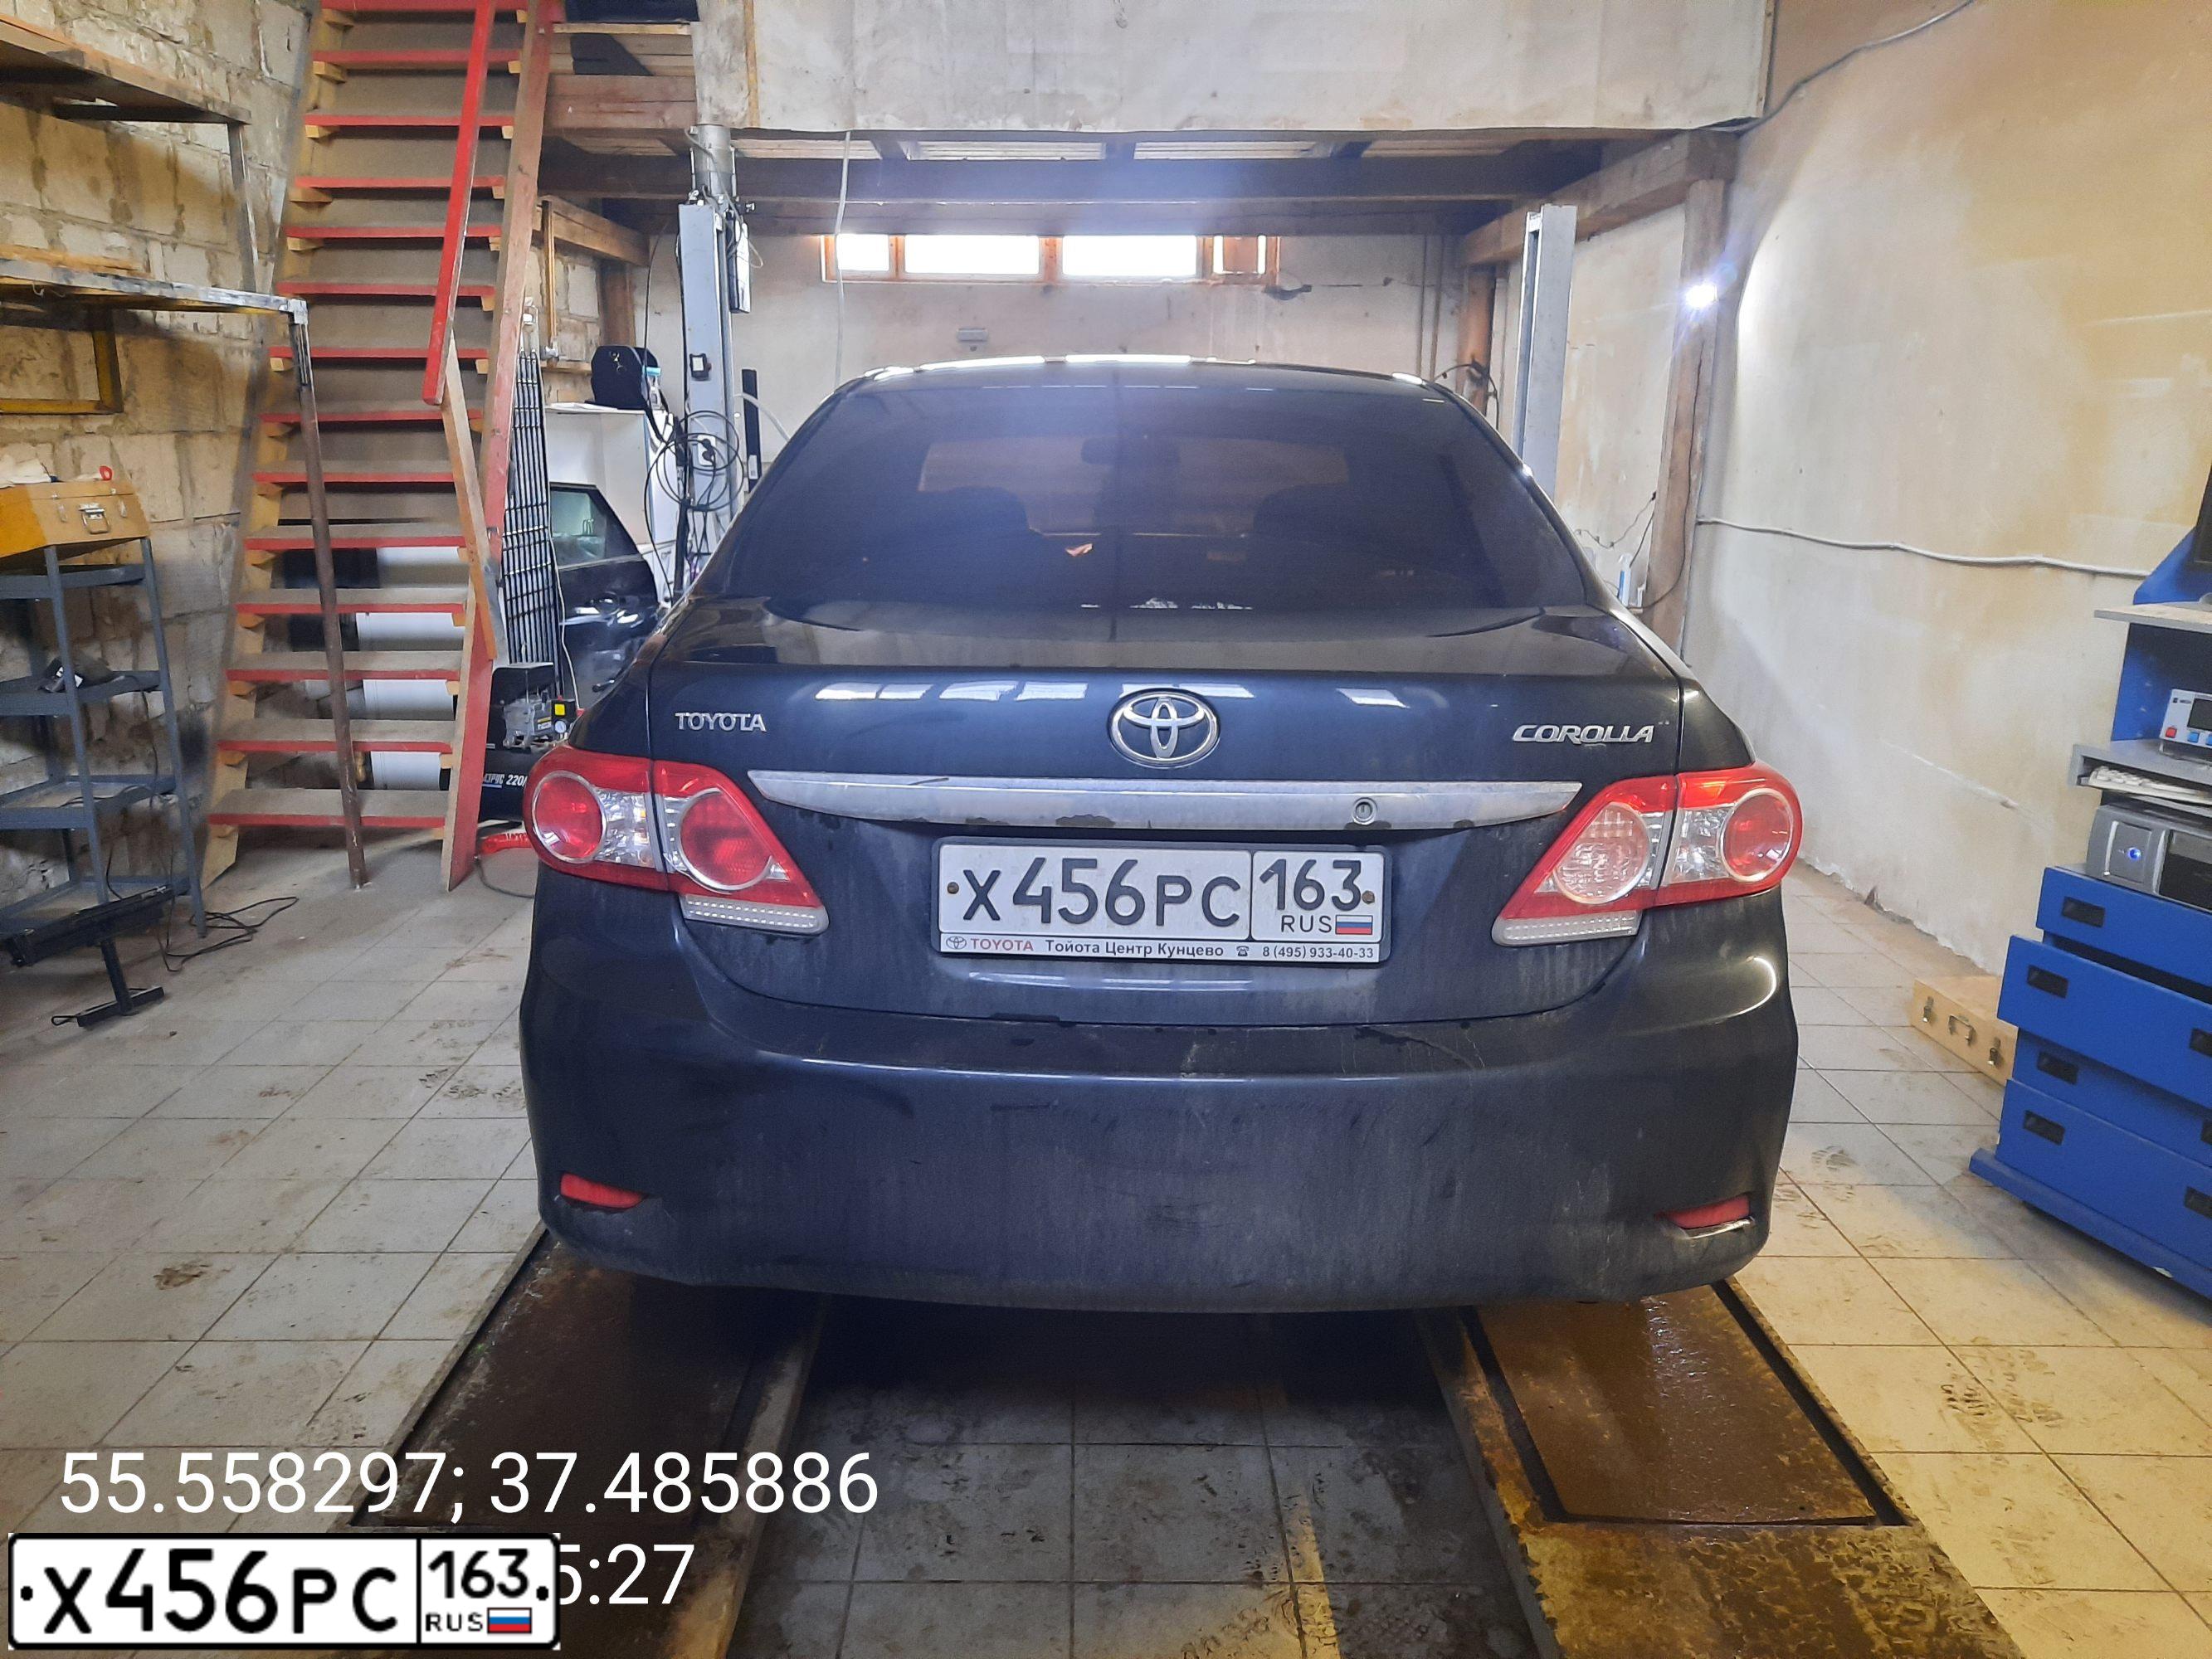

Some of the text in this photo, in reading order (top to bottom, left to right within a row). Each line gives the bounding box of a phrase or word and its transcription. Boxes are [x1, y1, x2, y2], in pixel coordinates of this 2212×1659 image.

[675, 712, 767, 732] TOYOTA
[1513, 724, 1654, 744] COROLLA
[1259, 859, 1362, 912] 163
[1281, 915, 1333, 933] RUS
[970, 938, 1374, 959] TOYOTA Тойота Центр Кунцево 8 (495) 933-40-33
